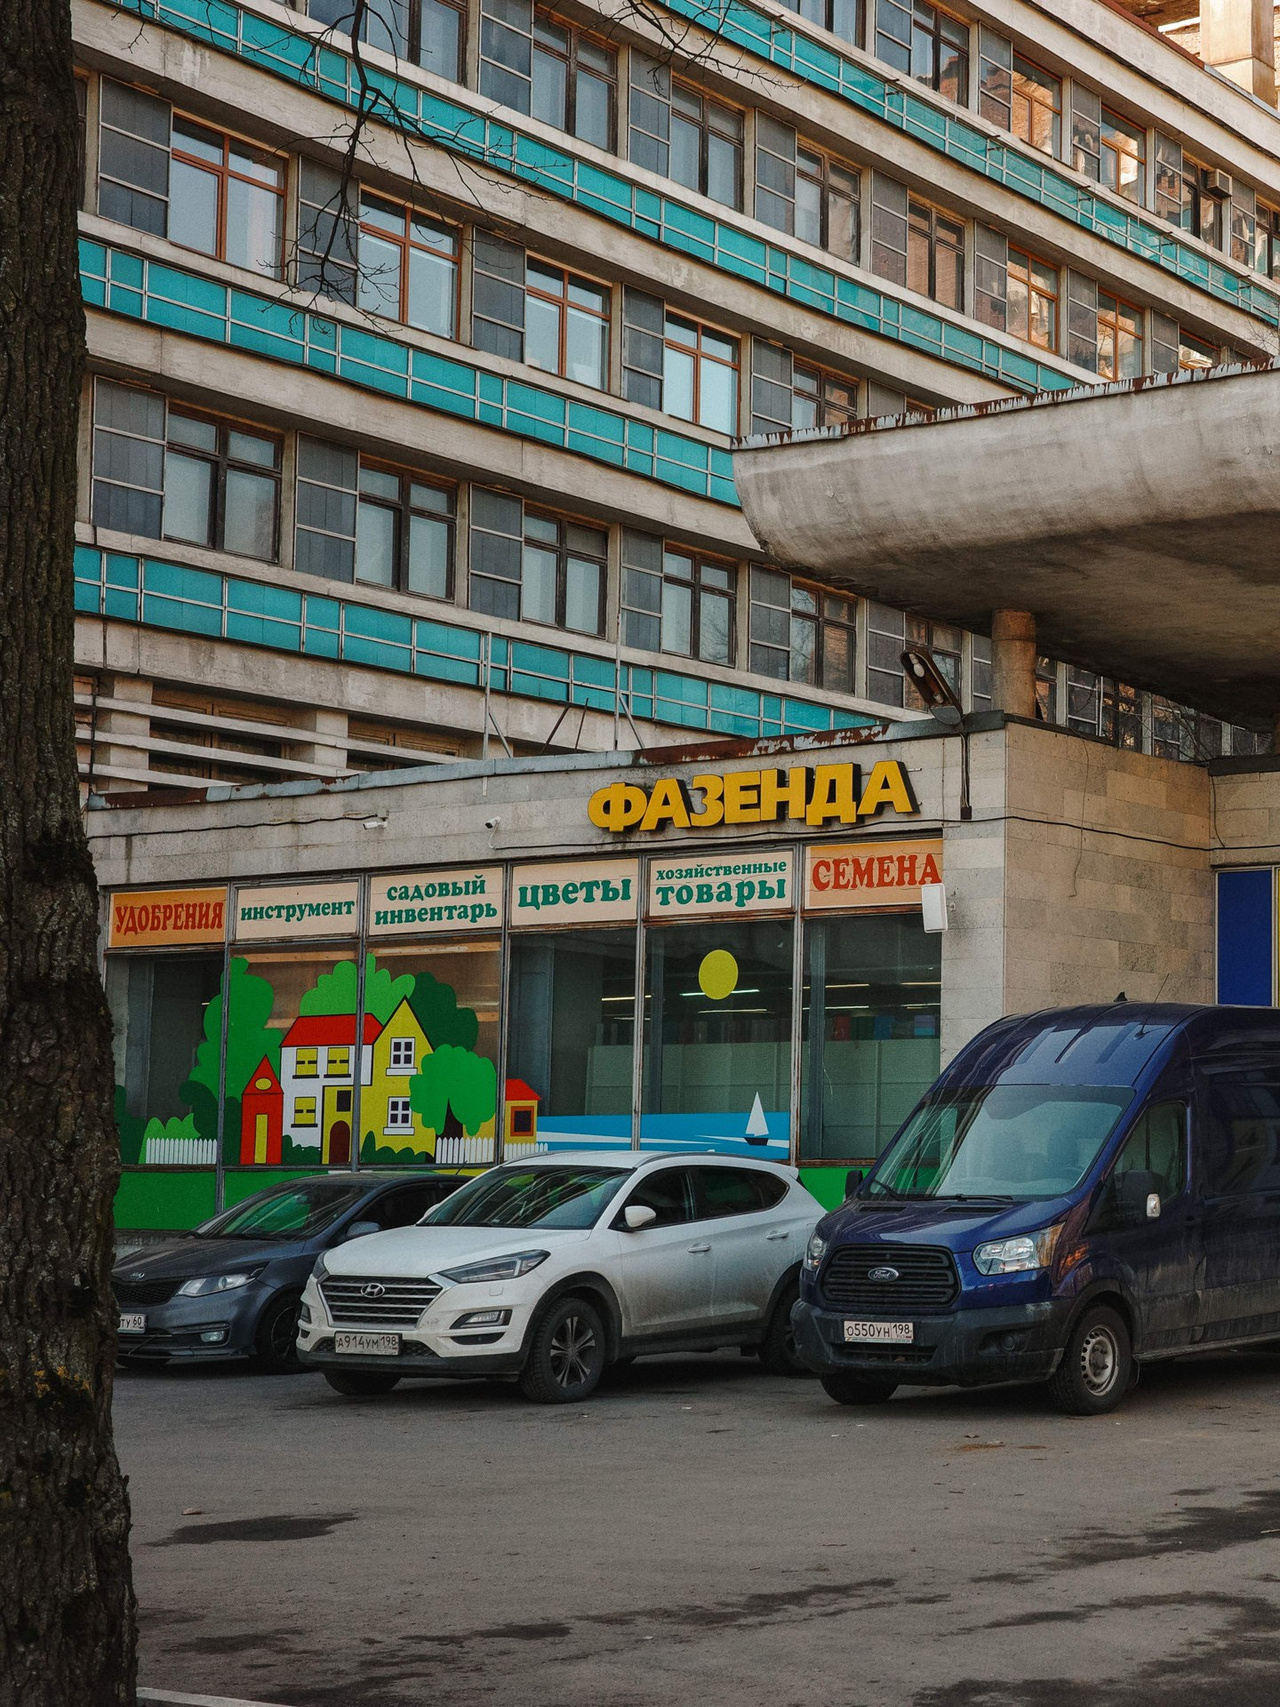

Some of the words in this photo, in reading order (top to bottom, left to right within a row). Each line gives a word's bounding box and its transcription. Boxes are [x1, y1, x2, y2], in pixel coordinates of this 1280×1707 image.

[587, 760, 920, 833] ФАЗЕНДА
[655, 858, 788, 881] хозяйственные
[812, 853, 943, 892] СЕМЕНА
[387, 874, 486, 903] садовый
[517, 877, 632, 911] цветы
[655, 878, 787, 908] товары
[114, 901, 224, 936] УДОБРЕНИЯ
[240, 899, 355, 926] инструмент
[374, 903, 498, 927] инвентарь
